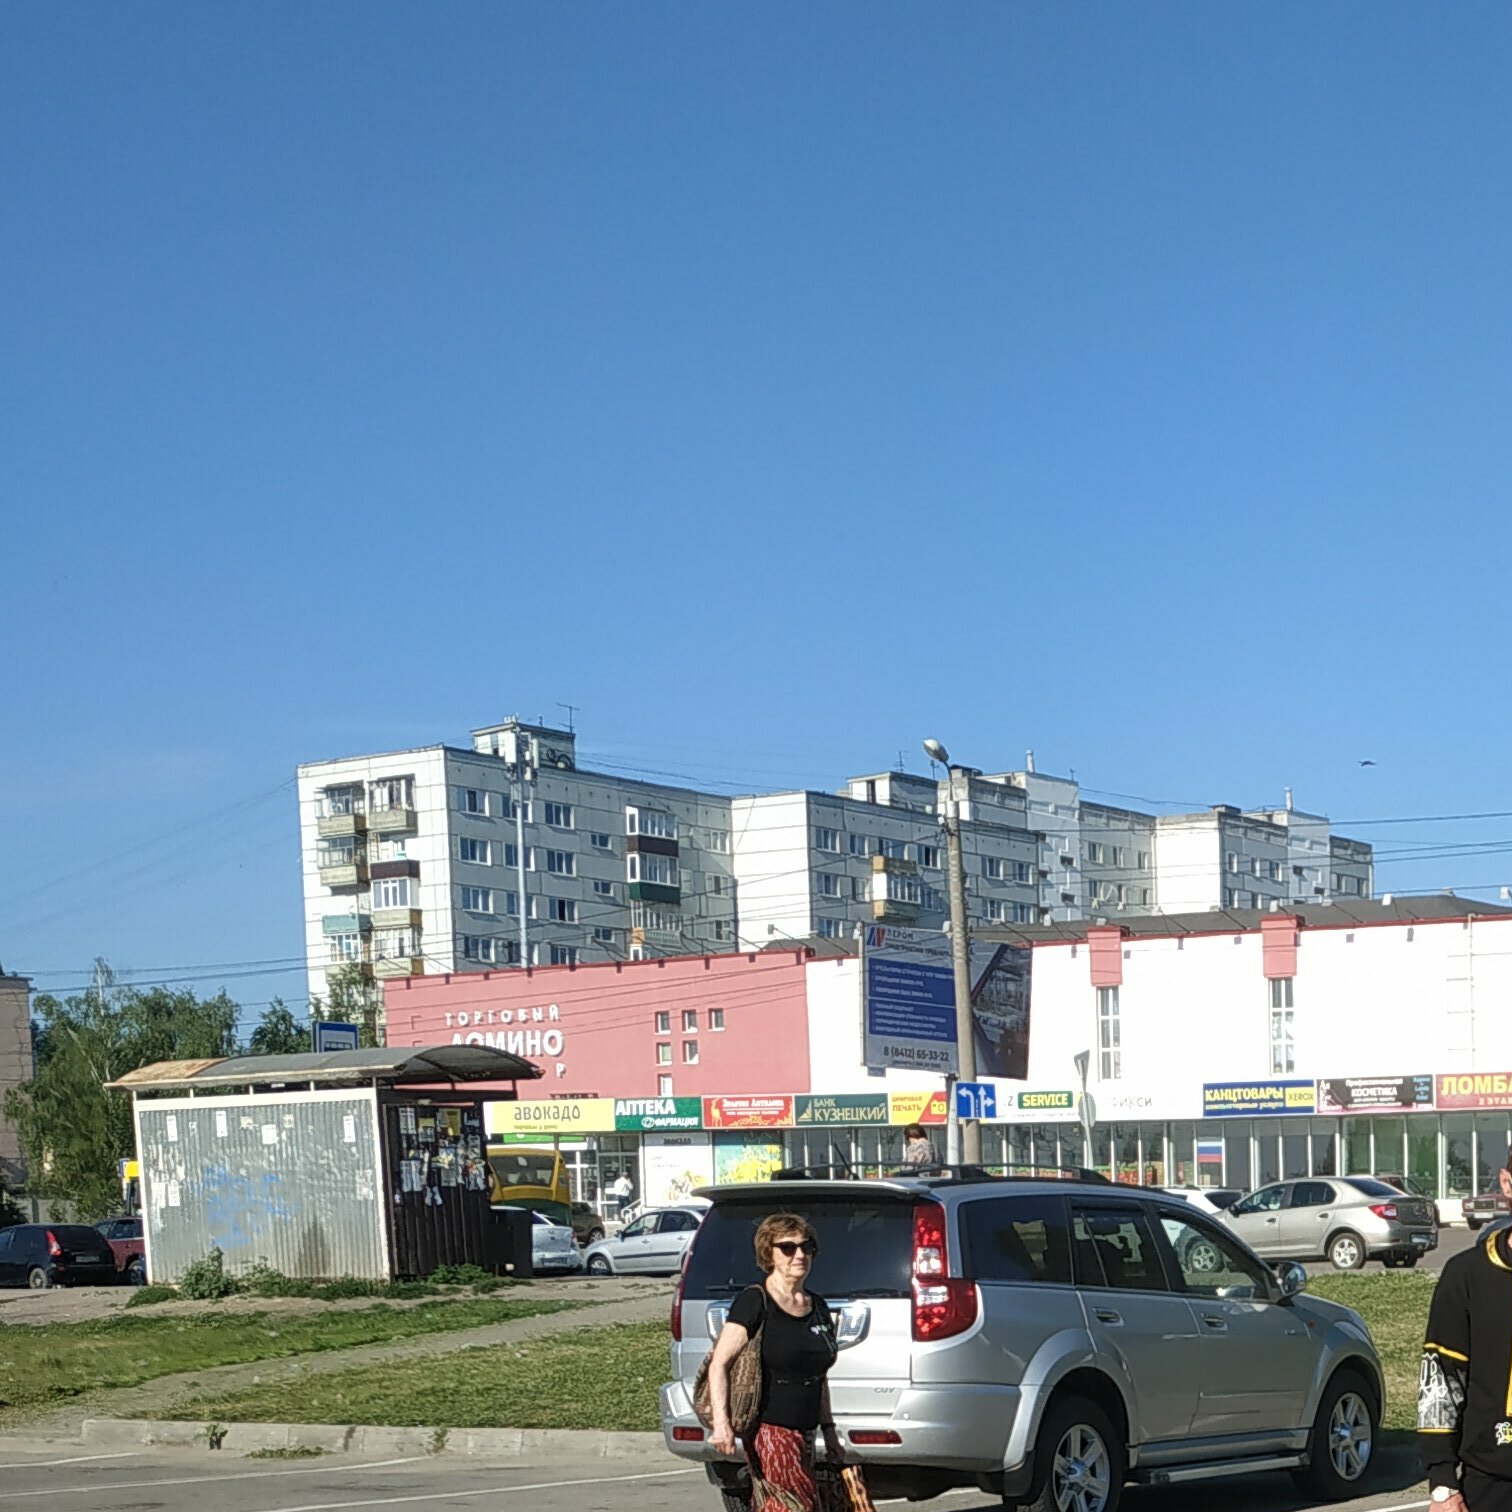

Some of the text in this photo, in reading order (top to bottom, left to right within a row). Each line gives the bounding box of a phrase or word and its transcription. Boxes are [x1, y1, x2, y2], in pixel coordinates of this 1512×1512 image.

[444, 1004, 560, 1027] ТОРГОВЫЙ
[883, 1046, 890, 1057] 8
[916, 1049, 950, 1062] 65-33-22
[1022, 1093, 1069, 1107] SERVICE
[1205, 1086, 1284, 1103] КАНЦТОВАРЫ
[1288, 1092, 1314, 1102] XEROX
[1351, 1087, 1398, 1098] КОСМЕТИКА
[615, 1099, 677, 1116] АПТЕКА
[813, 1098, 836, 1107] БАНК
[892, 1104, 922, 1112] ПЕЧАТЬ
[514, 1105, 581, 1122] авокадо
[813, 1103, 887, 1122] КУЗНЕЦКИЙ
